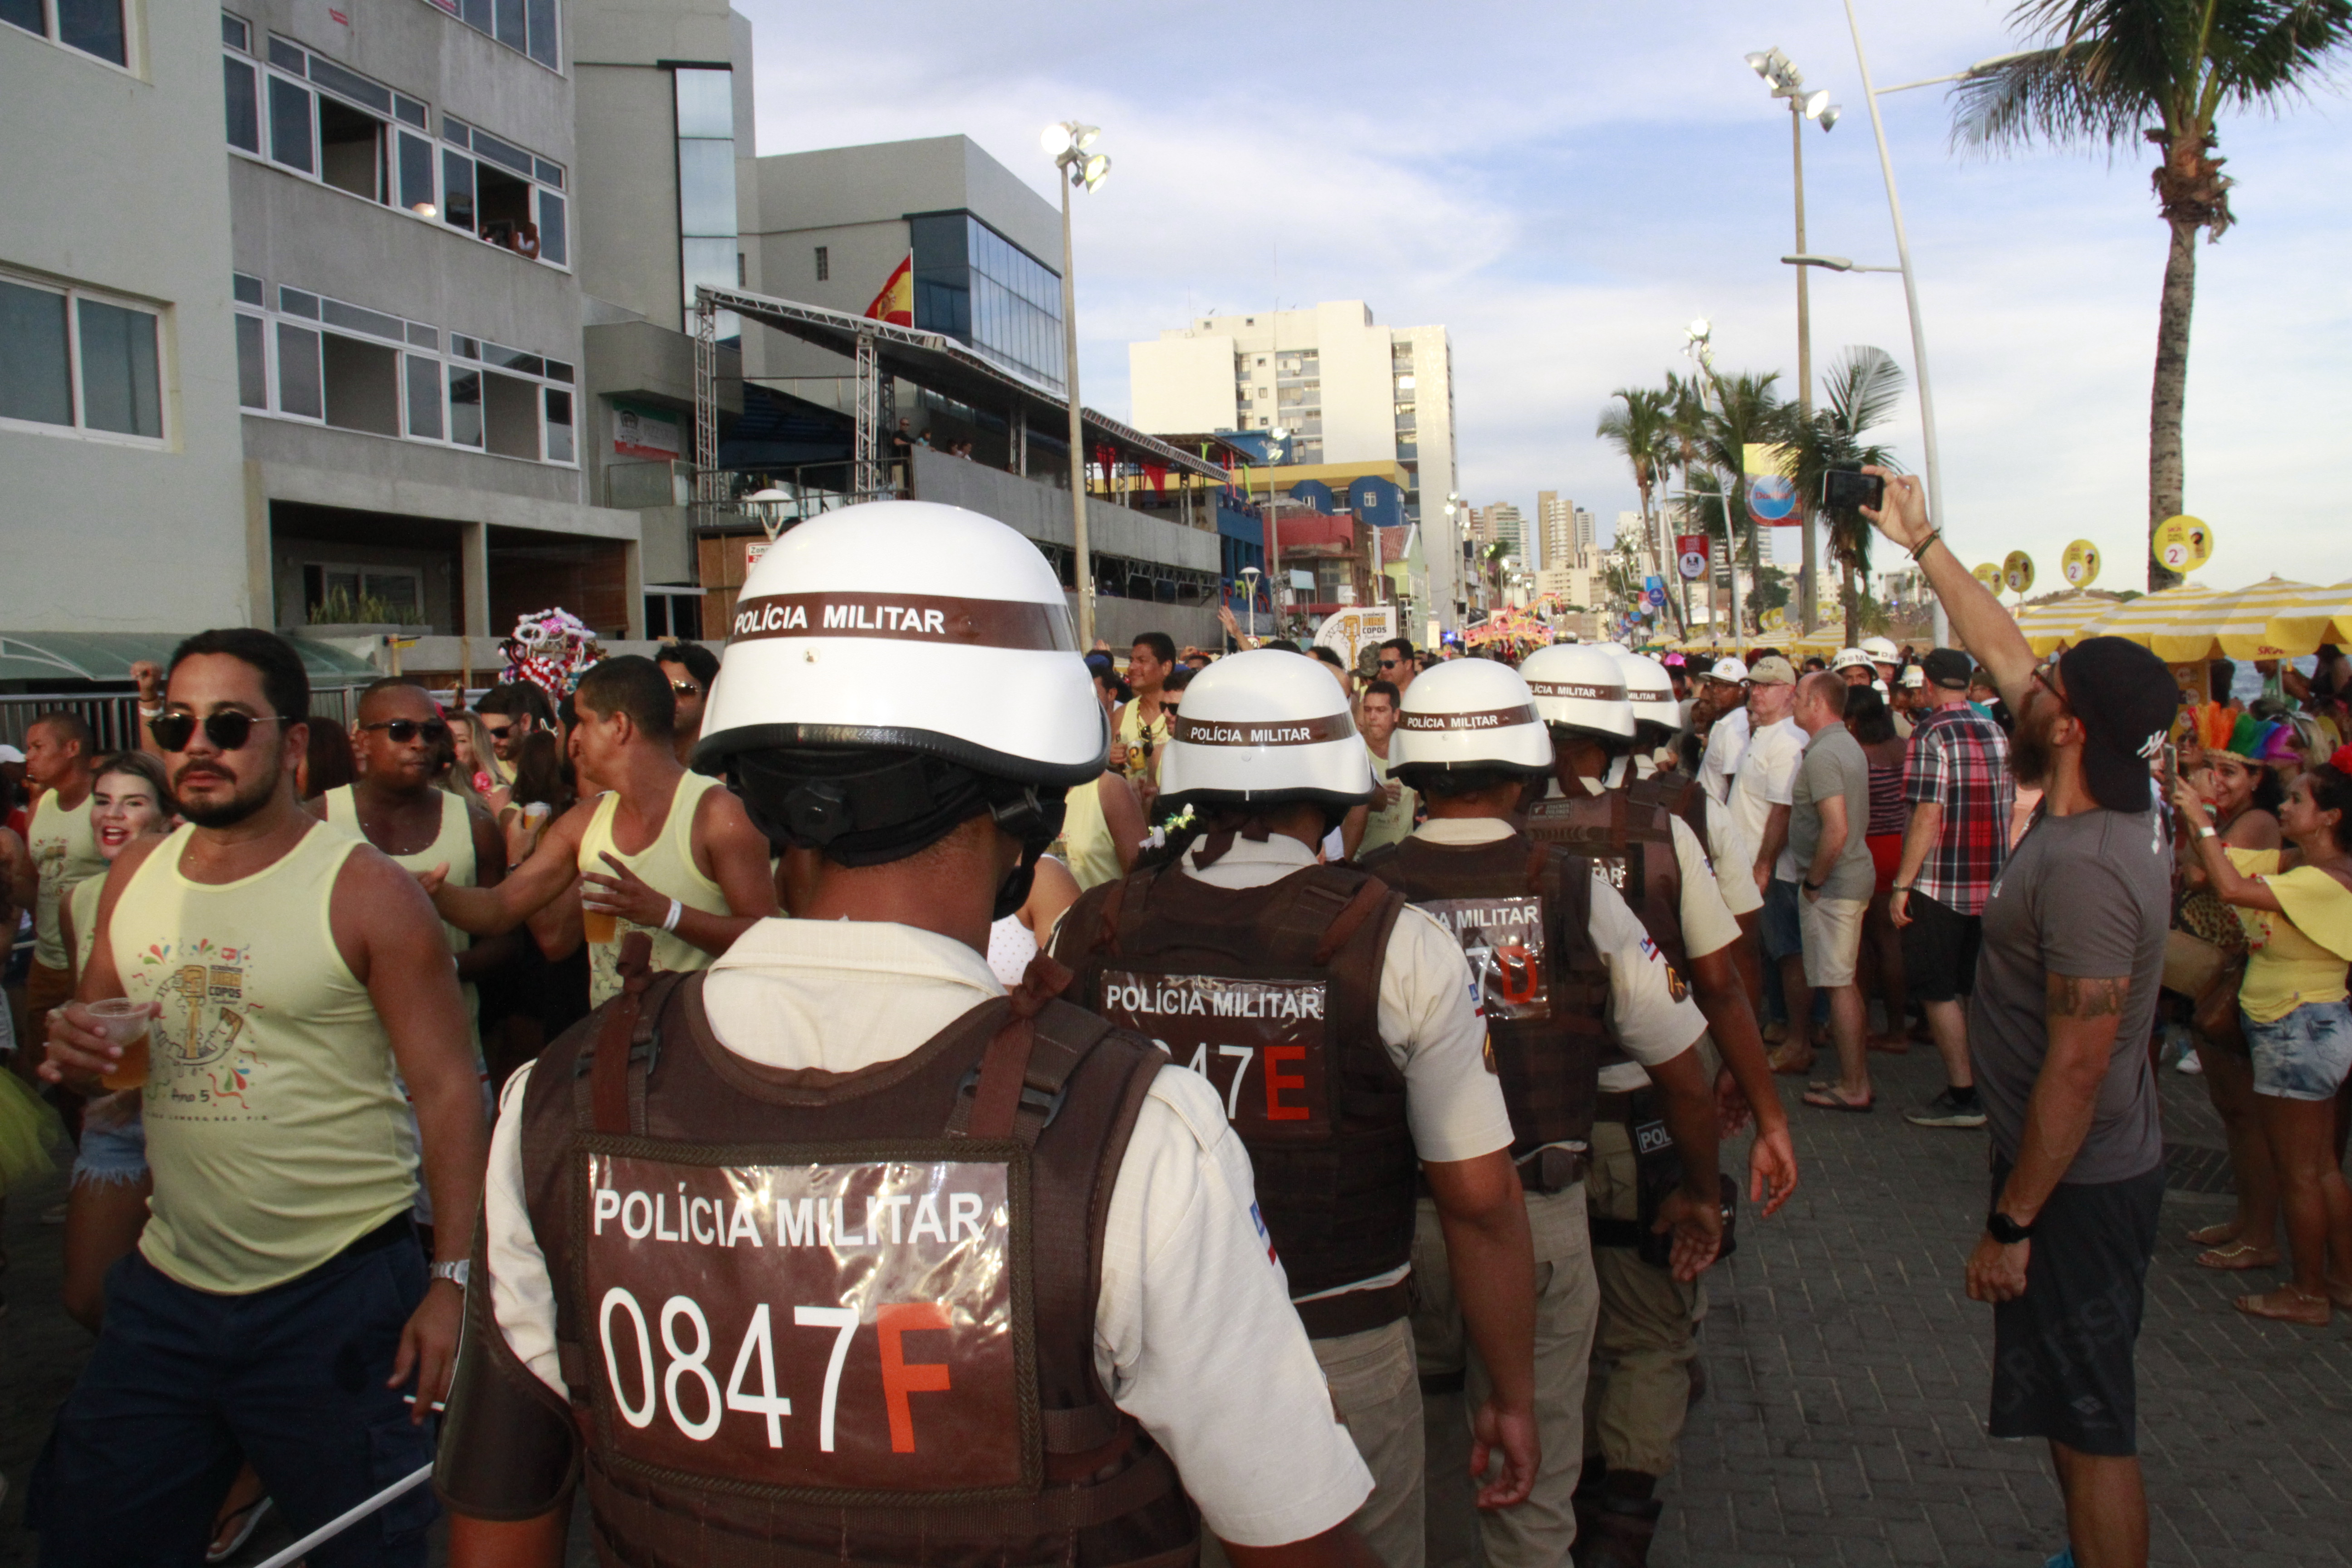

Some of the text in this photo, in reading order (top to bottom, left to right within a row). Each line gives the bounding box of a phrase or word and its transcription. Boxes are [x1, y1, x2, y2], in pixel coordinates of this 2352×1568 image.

[733, 603, 946, 635] POLÍCIA MILITAR
[1527, 683, 1596, 697] LÍCIA MILITAR
[1628, 691, 1656, 701] MILITAR
[1407, 715, 1498, 728] POLÍCIA MILITAR
[1191, 726, 1311, 742] POLÍCIA MILITAR
[1456, 905, 1539, 928] MILITAR
[209, 986, 242, 999] COPOS
[1106, 982, 1321, 1019] POLÍCIA MILITAR
[200, 1089, 210, 1102] 5
[594, 1181, 985, 1248] POLÍCIA MILITAR
[599, 1286, 953, 1454] 0847F
